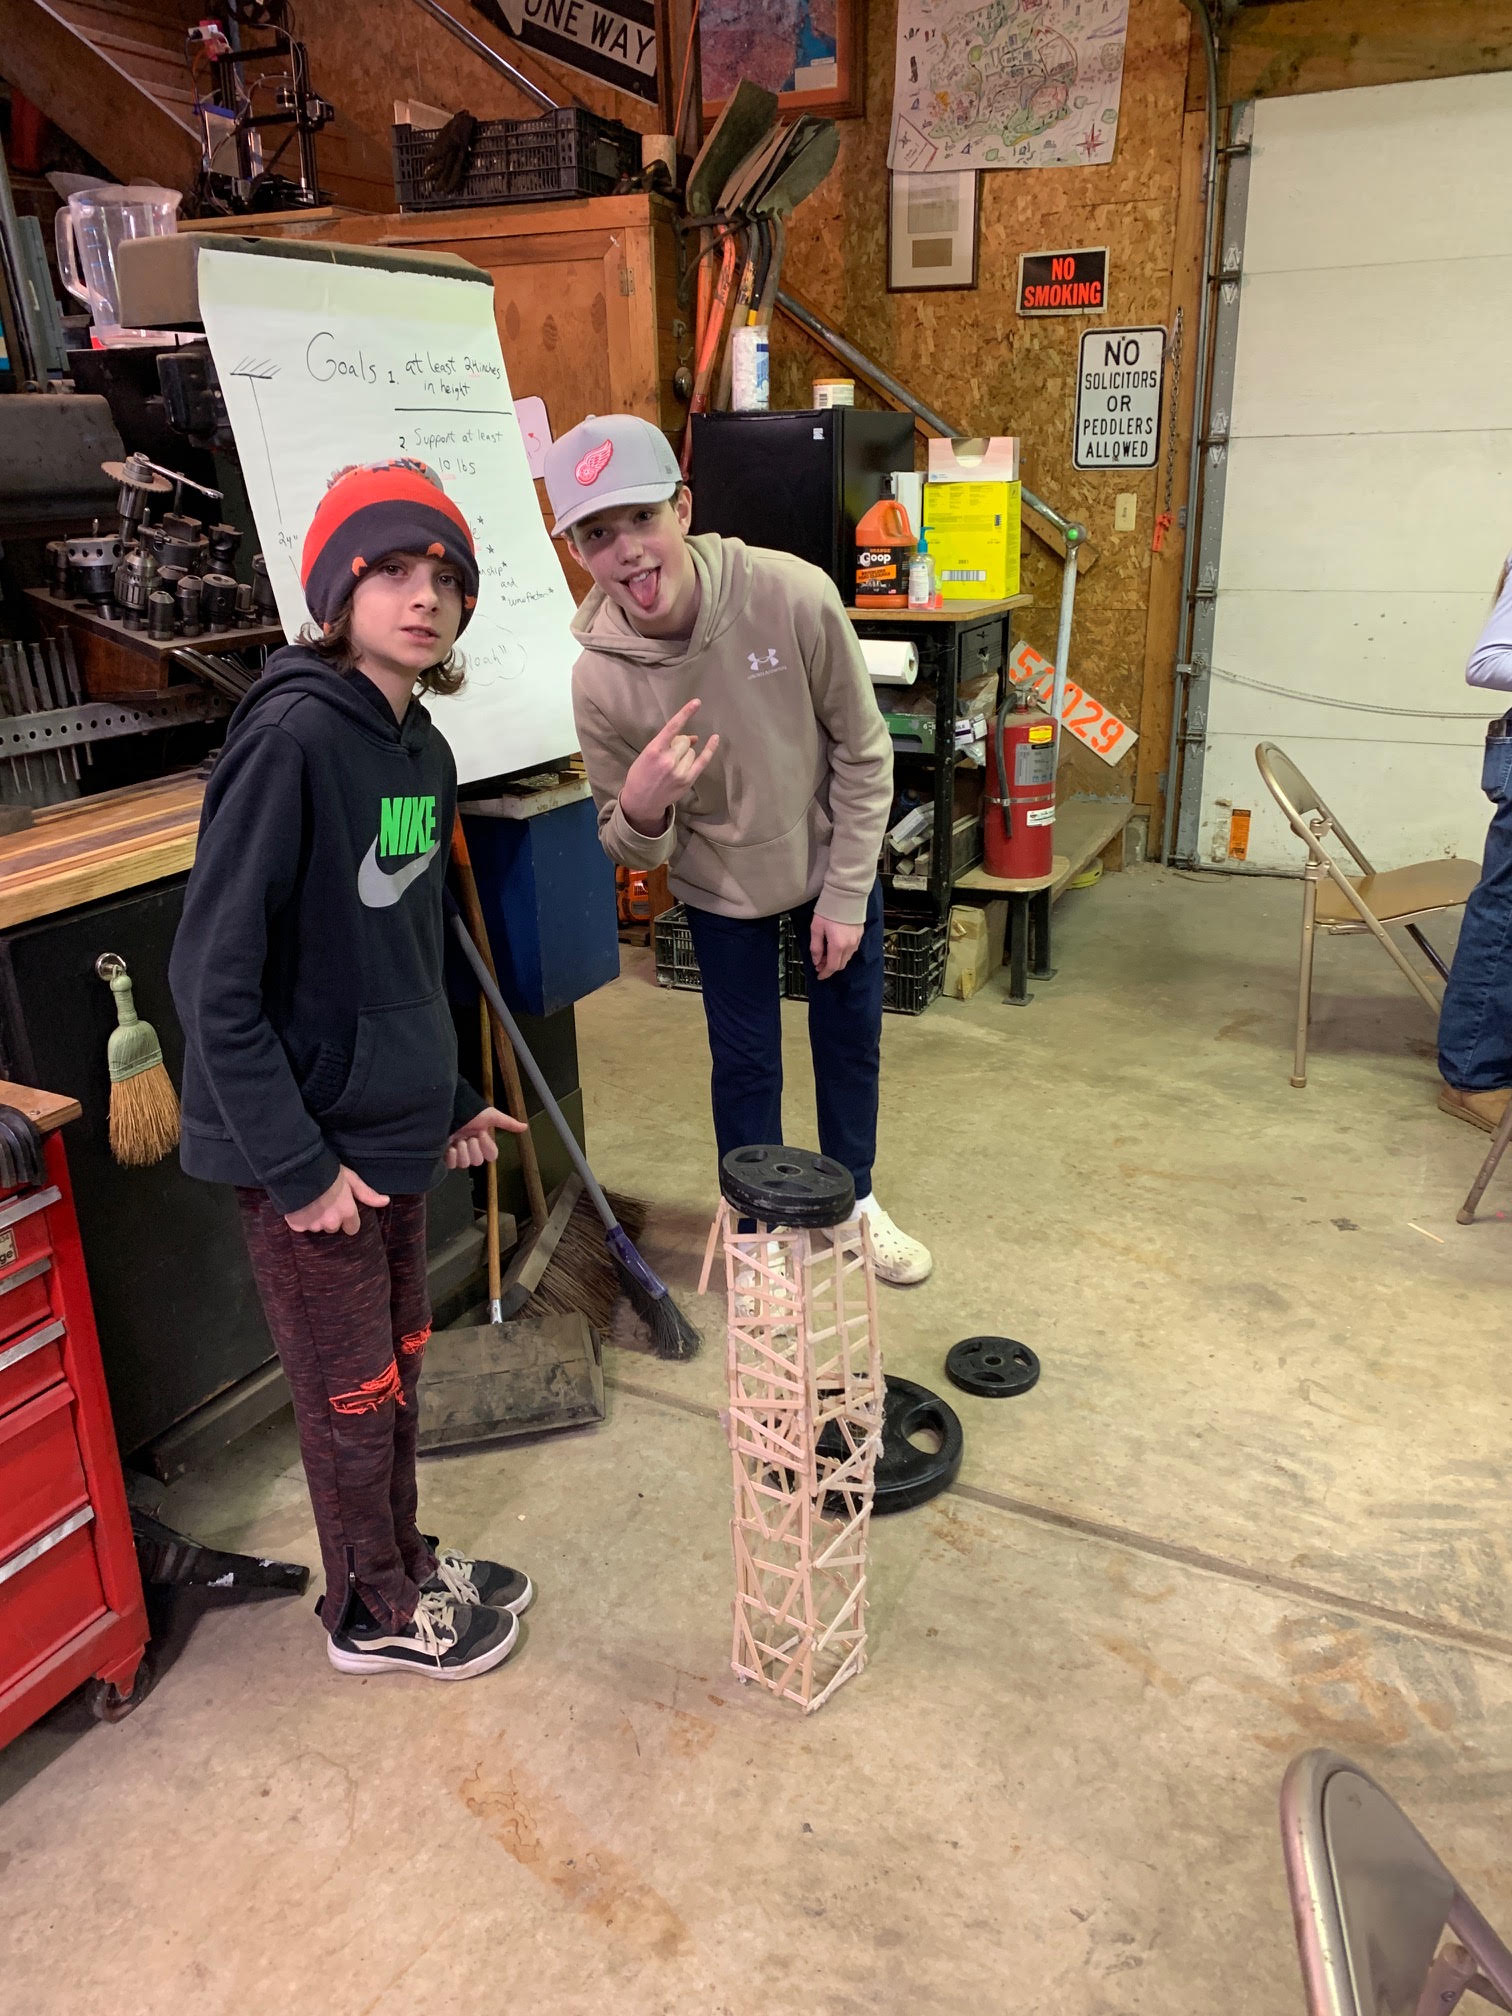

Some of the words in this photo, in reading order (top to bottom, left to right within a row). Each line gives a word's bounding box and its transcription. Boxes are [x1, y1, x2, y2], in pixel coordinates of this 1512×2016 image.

[591, 11, 655, 64] WAY
[1052, 257, 1075, 281] NO
[1024, 281, 1101, 308] SMOKING
[307, 332, 377, 384] Goals
[1104, 339, 1140, 366] NO
[388, 370, 400, 385] 1.
[405, 352, 423, 375] at
[427, 352, 456, 375] least
[1085, 370, 1157, 390] SOLICITORS
[424, 380, 435, 394] in
[440, 378, 471, 401] height
[1107, 395, 1131, 412] OR
[1083, 417, 1153, 436] PEDDLERS
[399, 436, 408, 451] 2.
[414, 428, 455, 450] Support
[462, 429, 473, 443] at
[477, 428, 504, 443] least
[1086, 440, 1148, 459] ALLOWED
[439, 457, 451, 472] 10
[457, 458, 476, 475] lbs
[859, 552, 891, 567] Goop
[380, 795, 436, 858] NIKE
